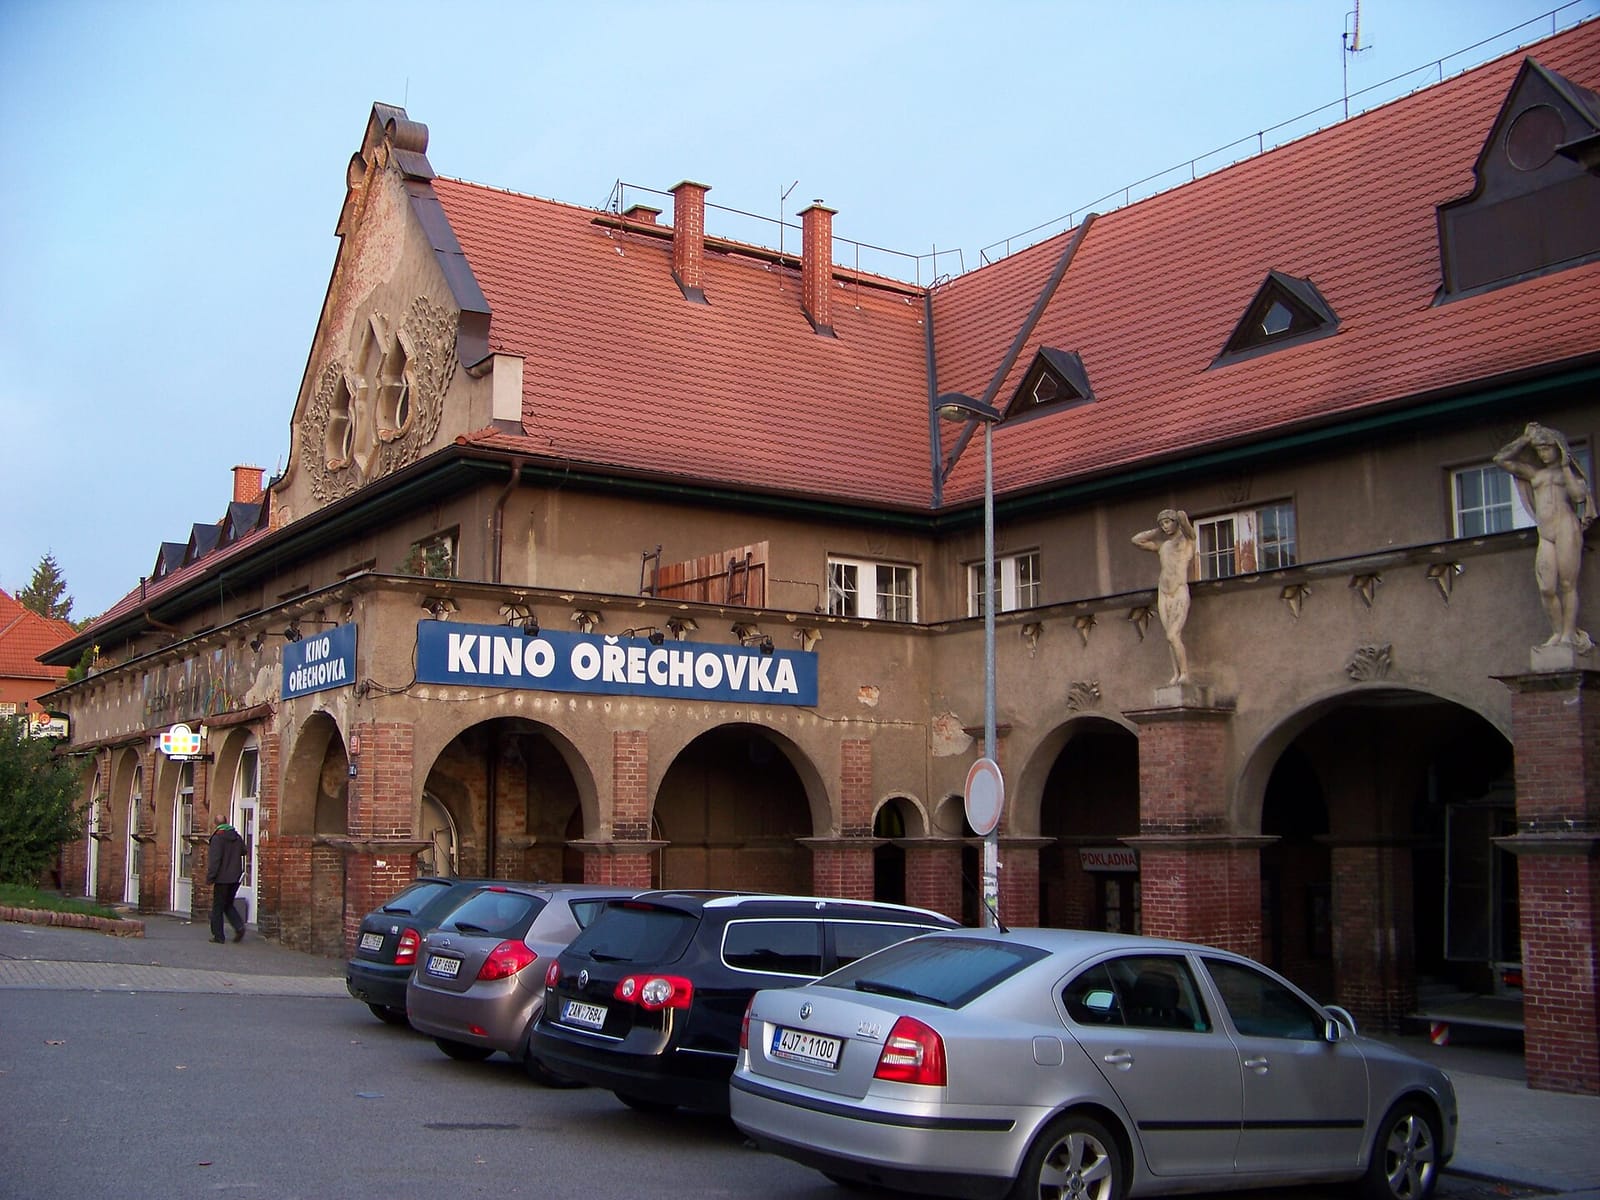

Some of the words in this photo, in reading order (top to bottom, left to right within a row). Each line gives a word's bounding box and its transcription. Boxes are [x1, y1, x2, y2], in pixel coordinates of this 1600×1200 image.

[305, 636, 330, 664] KINO
[449, 633, 555, 678] KINO
[571, 634, 799, 693] OŘECHOVKA
[289, 657, 346, 692] OŘECHOVKA
[1080, 852, 1135, 866] POKLADNA
[781, 1032, 801, 1051] 4J7
[808, 1037, 835, 1058] 1100
